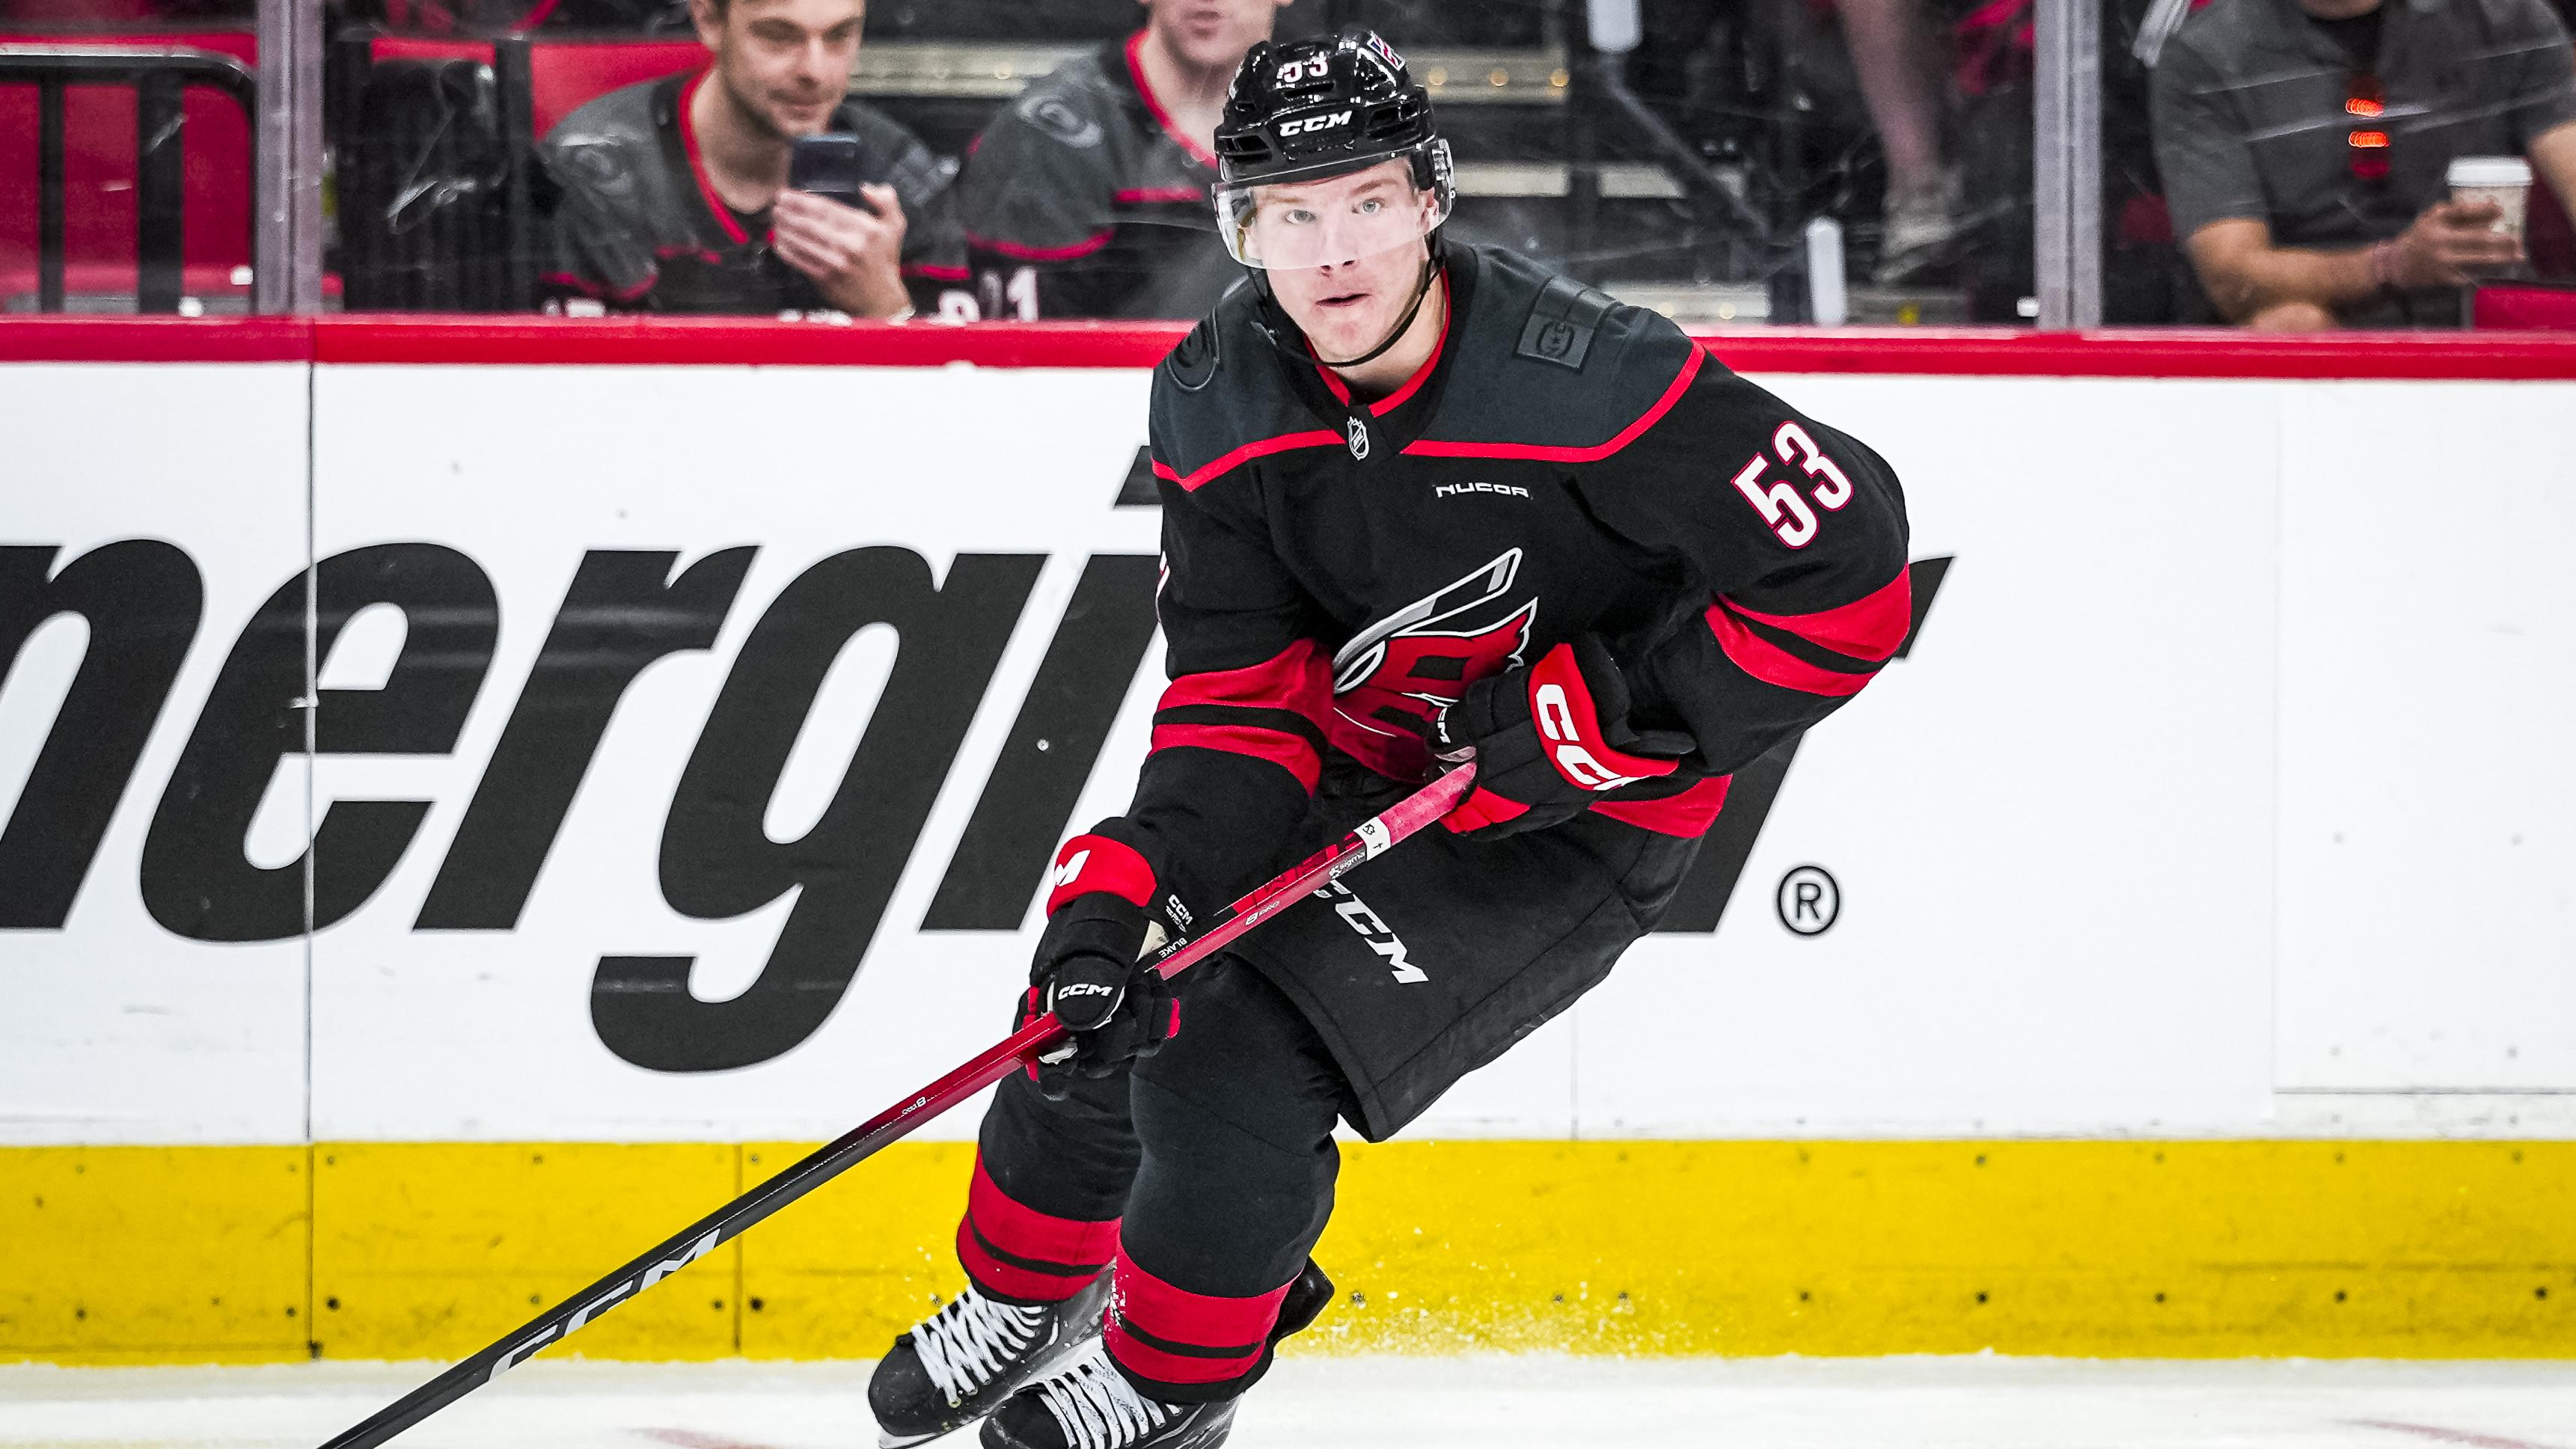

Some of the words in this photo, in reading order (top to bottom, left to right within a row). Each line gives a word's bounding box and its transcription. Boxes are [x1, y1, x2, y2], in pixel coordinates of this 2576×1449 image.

[1279, 111, 1353, 136] CCM
[1435, 483, 1529, 498] NUCOR
[1731, 420, 1854, 549] 53
[1168, 894, 1193, 925] CCM
[1157, 937, 1187, 958] BLAKE
[1058, 983, 1113, 1000] CCM
[488, 1228, 721, 1382] CCM
